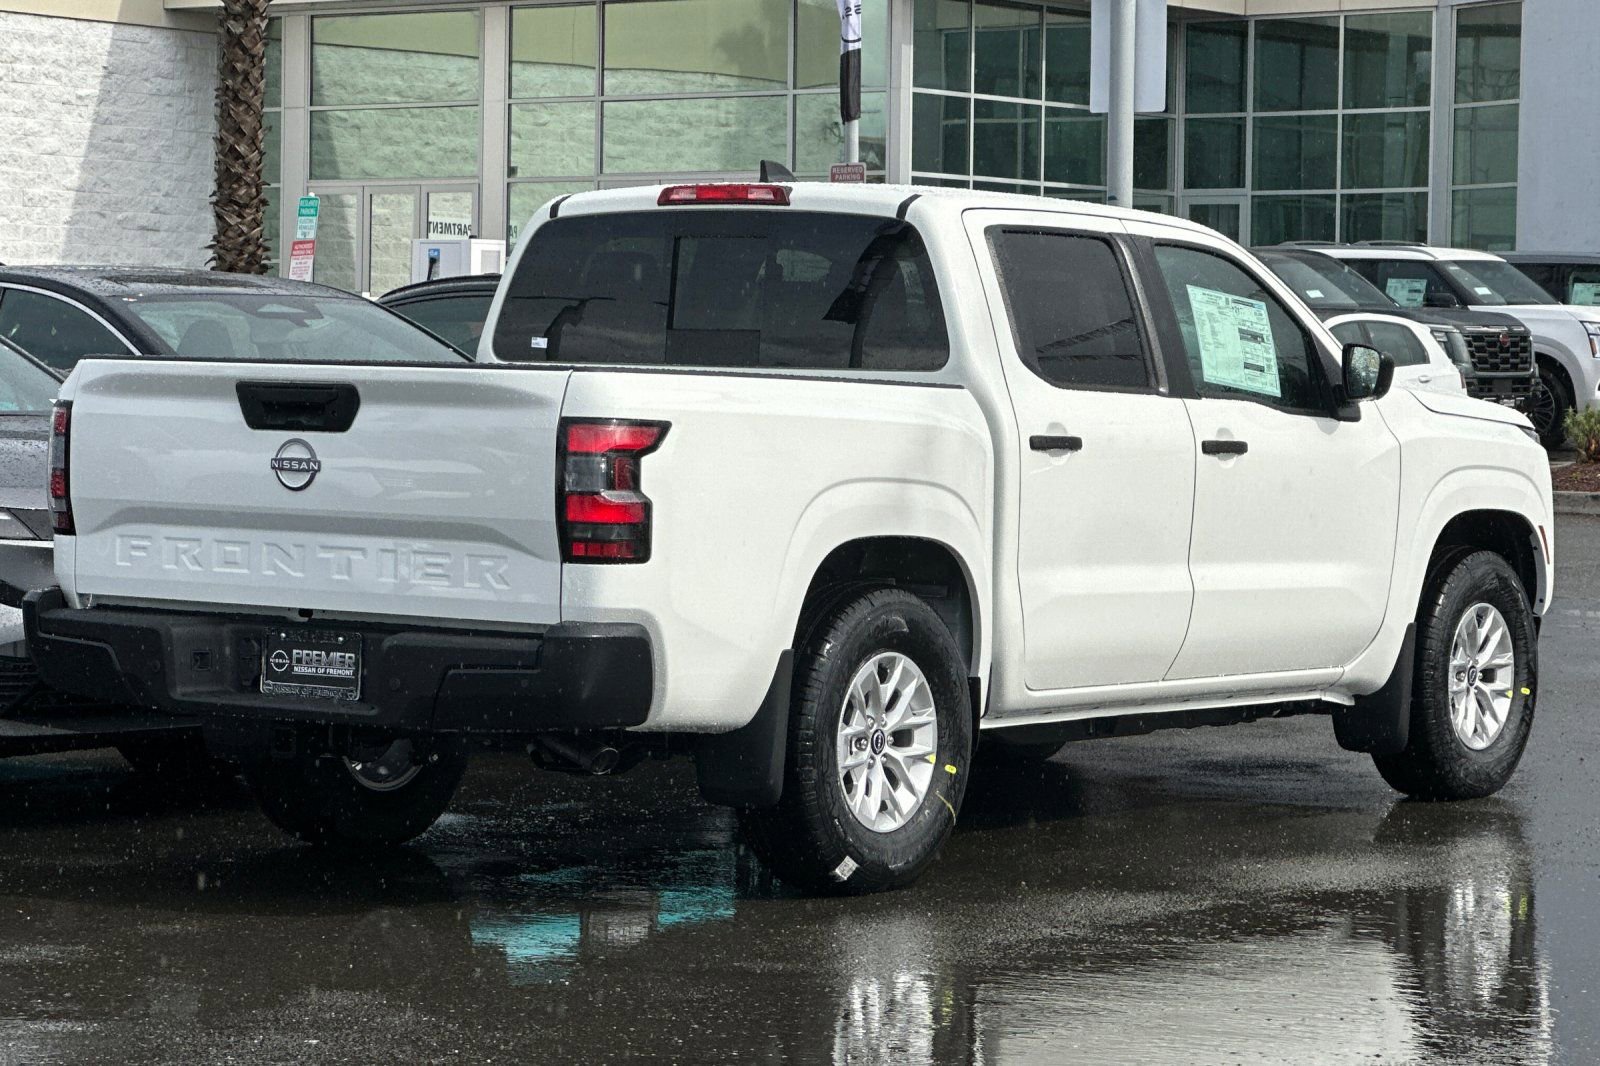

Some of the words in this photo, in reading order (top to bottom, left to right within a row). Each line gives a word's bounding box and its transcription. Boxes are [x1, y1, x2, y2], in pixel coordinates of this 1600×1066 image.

[271, 460, 319, 470] NISSAN
[115, 534, 512, 590] FRONTIER
[292, 649, 355, 668] PREMIER
[293, 666, 316, 674] NISSAN
